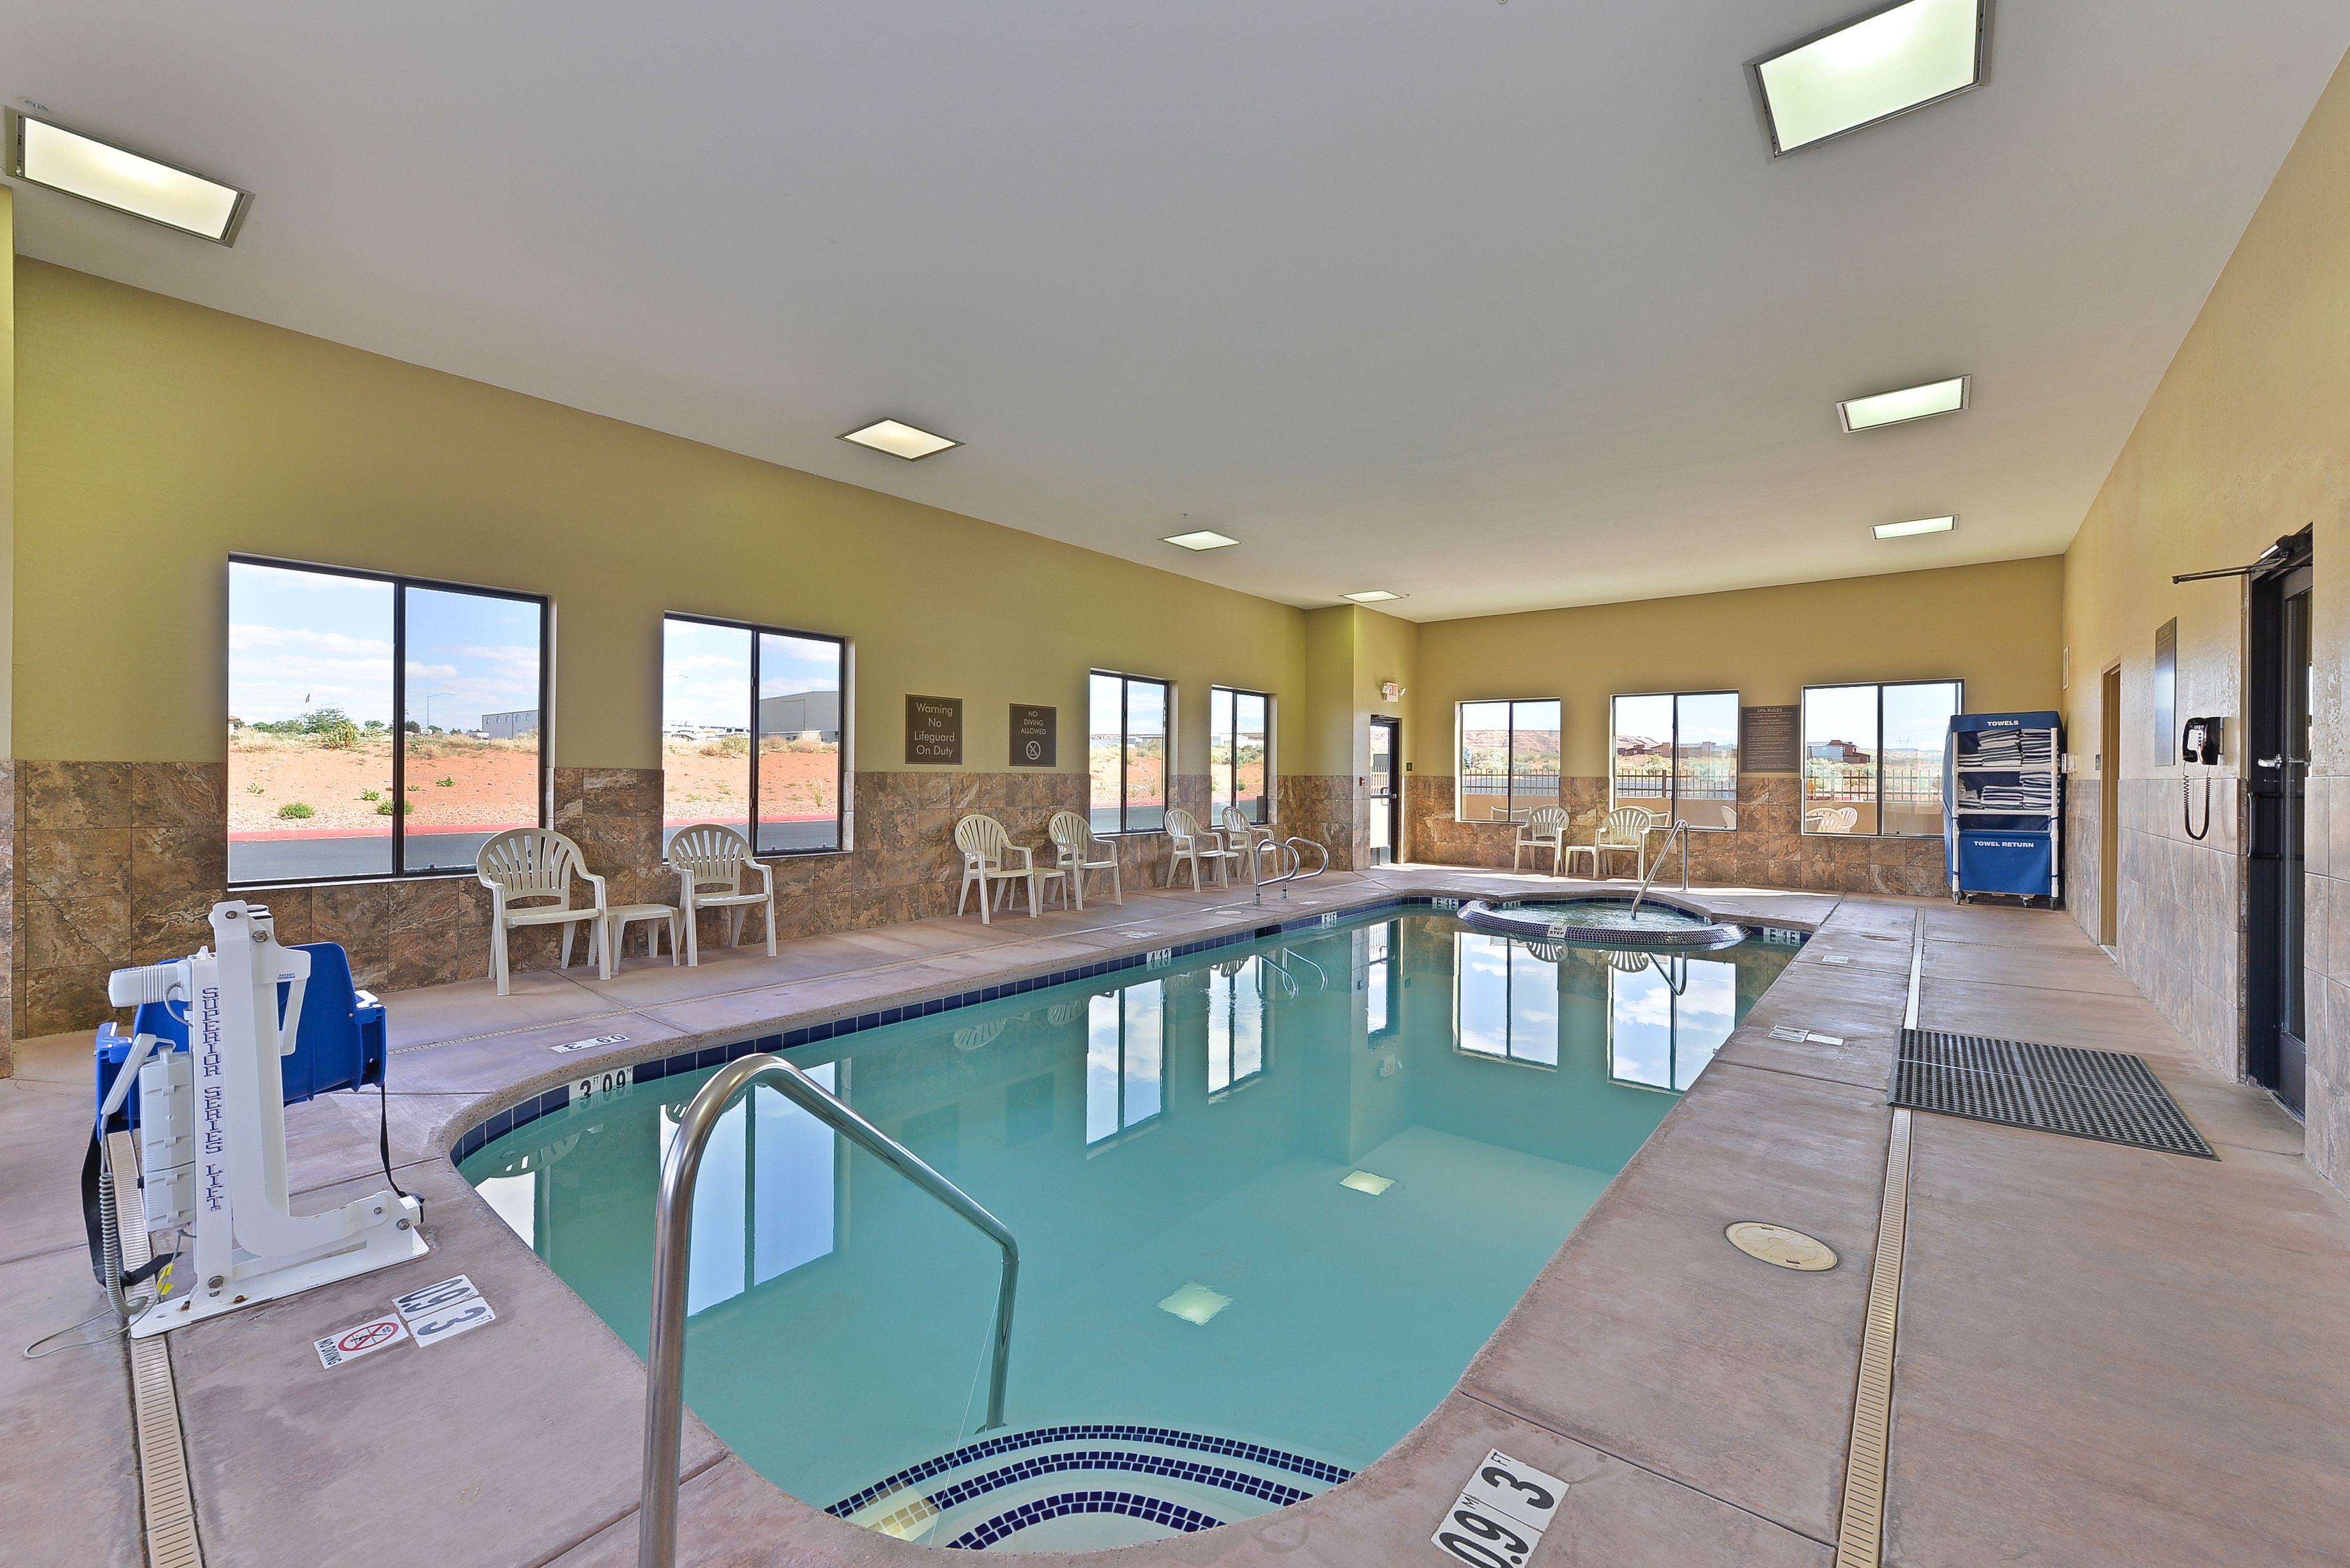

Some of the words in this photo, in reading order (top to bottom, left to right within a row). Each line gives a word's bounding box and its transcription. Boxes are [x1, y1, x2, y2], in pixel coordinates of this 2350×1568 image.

[916, 702, 953, 717] Warning
[928, 718, 942, 728] No
[914, 730, 955, 744] Lifeguard
[916, 744, 930, 755] On
[934, 746, 953, 758] Duty
[202, 987, 222, 1078] SUPERIOR
[579, 1080, 591, 1100] 3
[593, 1076, 599, 1085] FT
[204, 1087, 224, 1155] SERIES
[206, 1164, 224, 1209] LIFT
[397, 1278, 471, 1313] 0.9
[417, 1306, 487, 1336] 3
[474, 1314, 493, 1325] FT
[317, 1338, 334, 1348] NO
[321, 1345, 342, 1365] DIVING
[1490, 1452, 1512, 1466] FT
[1481, 1466, 1555, 1510] 3
[1461, 1497, 1480, 1509] M
